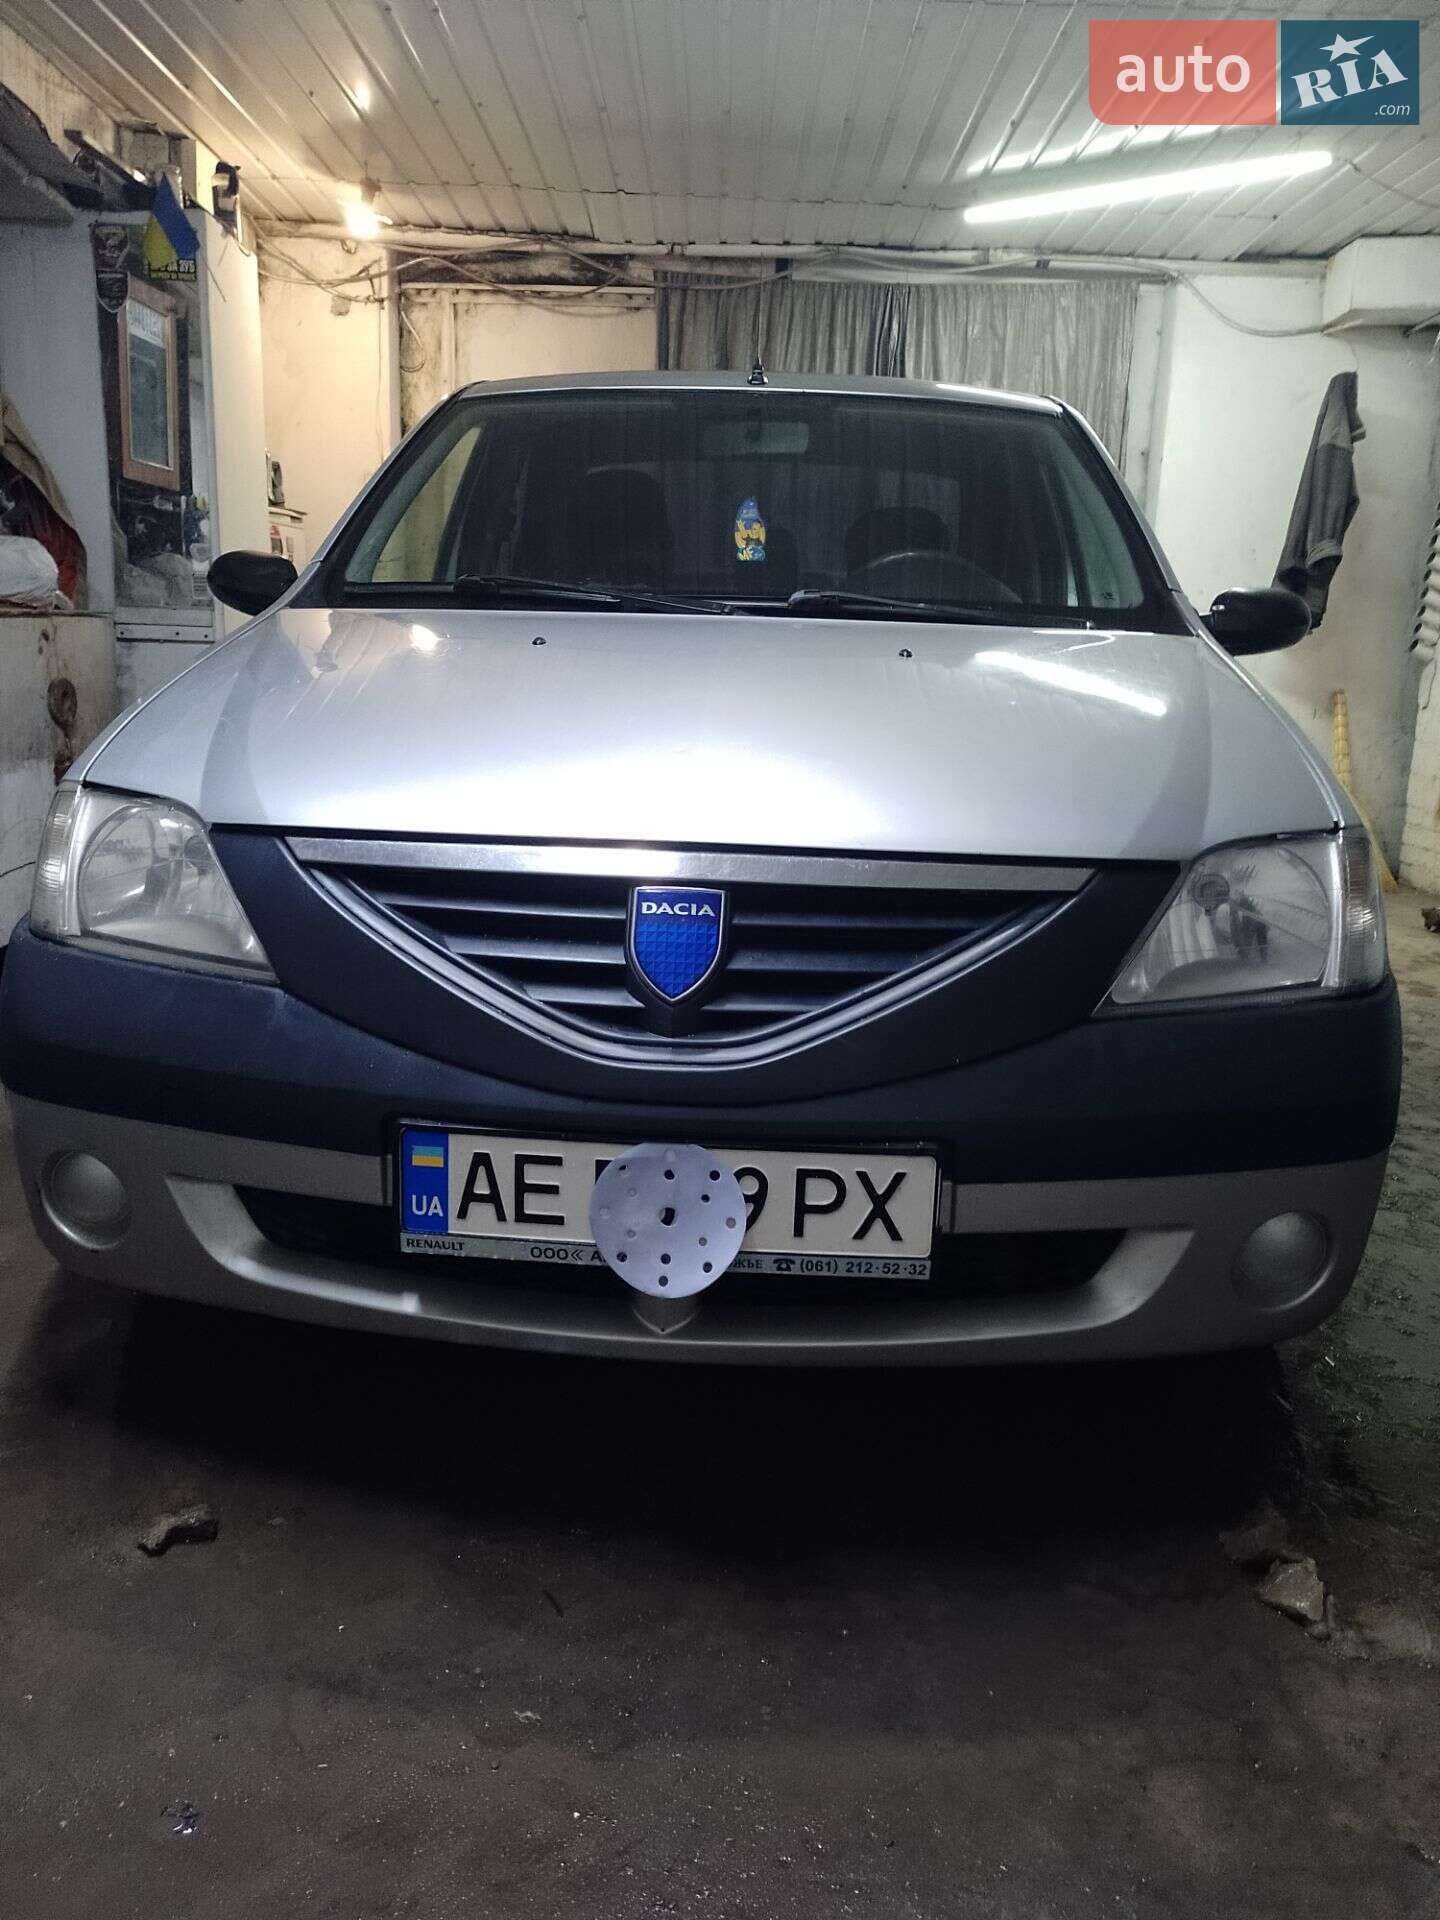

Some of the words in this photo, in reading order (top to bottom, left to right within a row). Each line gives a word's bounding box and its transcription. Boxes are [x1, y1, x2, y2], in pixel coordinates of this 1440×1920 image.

[641, 902, 716, 917] DACIA
[457, 1151, 565, 1225] AE
[793, 1168, 907, 1241] PX
[411, 1194, 444, 1218] UA
[406, 1238, 465, 1251] RENAULT
[800, 1258, 838, 1274] (061)
